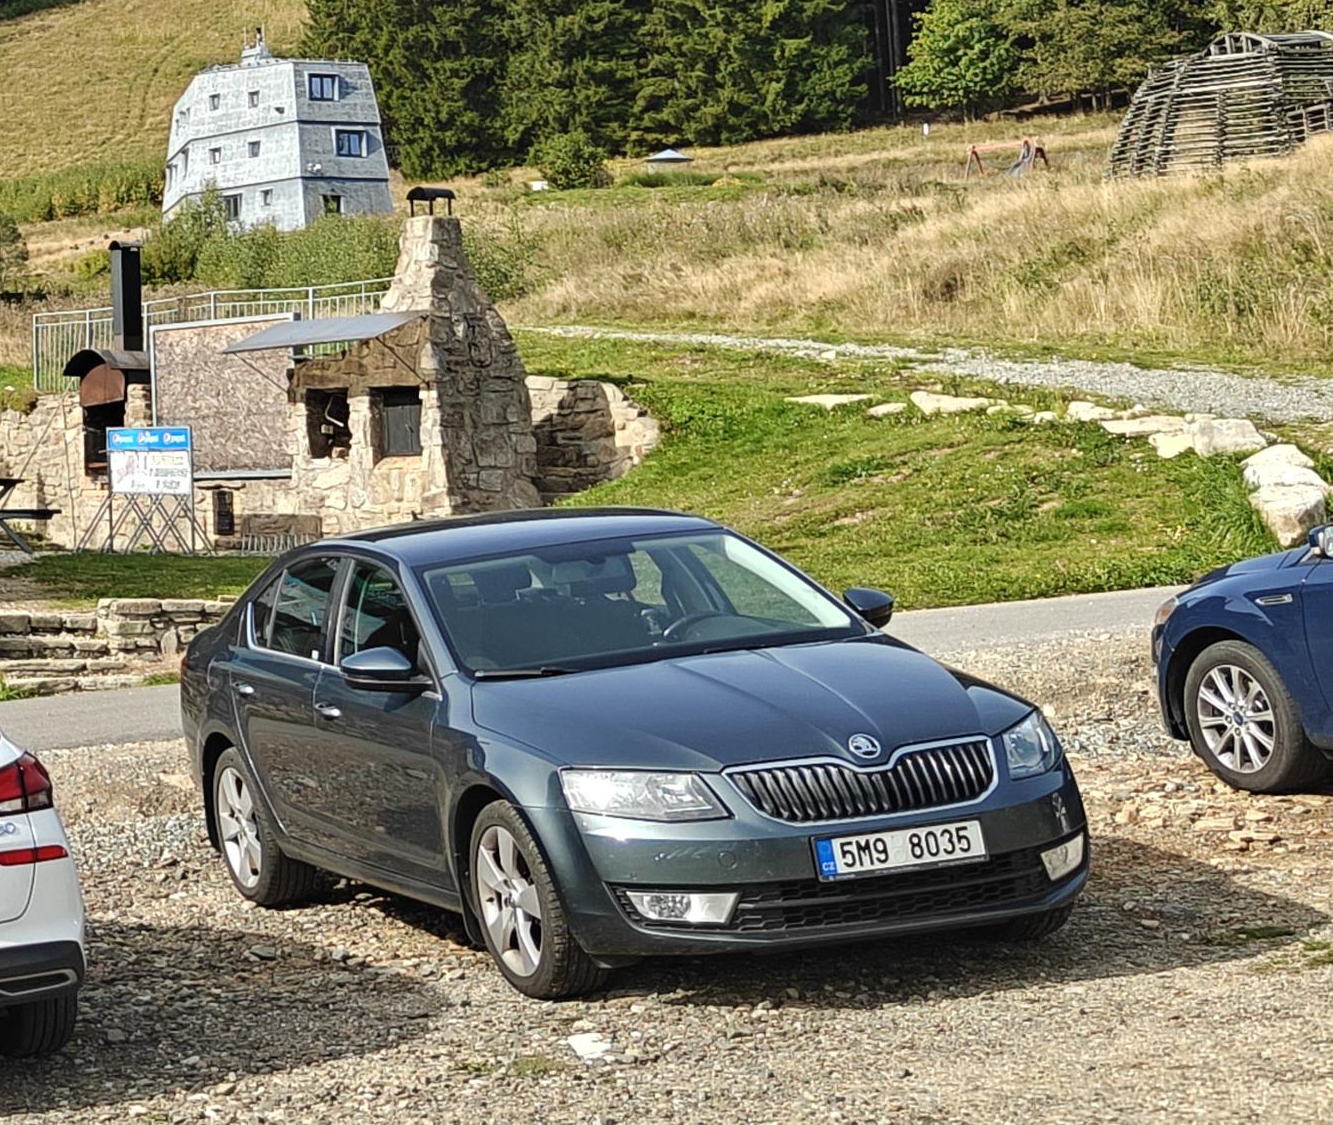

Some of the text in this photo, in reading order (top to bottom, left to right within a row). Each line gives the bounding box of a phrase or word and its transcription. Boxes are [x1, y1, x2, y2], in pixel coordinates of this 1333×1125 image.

[822, 826, 972, 872] CZ 5M9 8035
